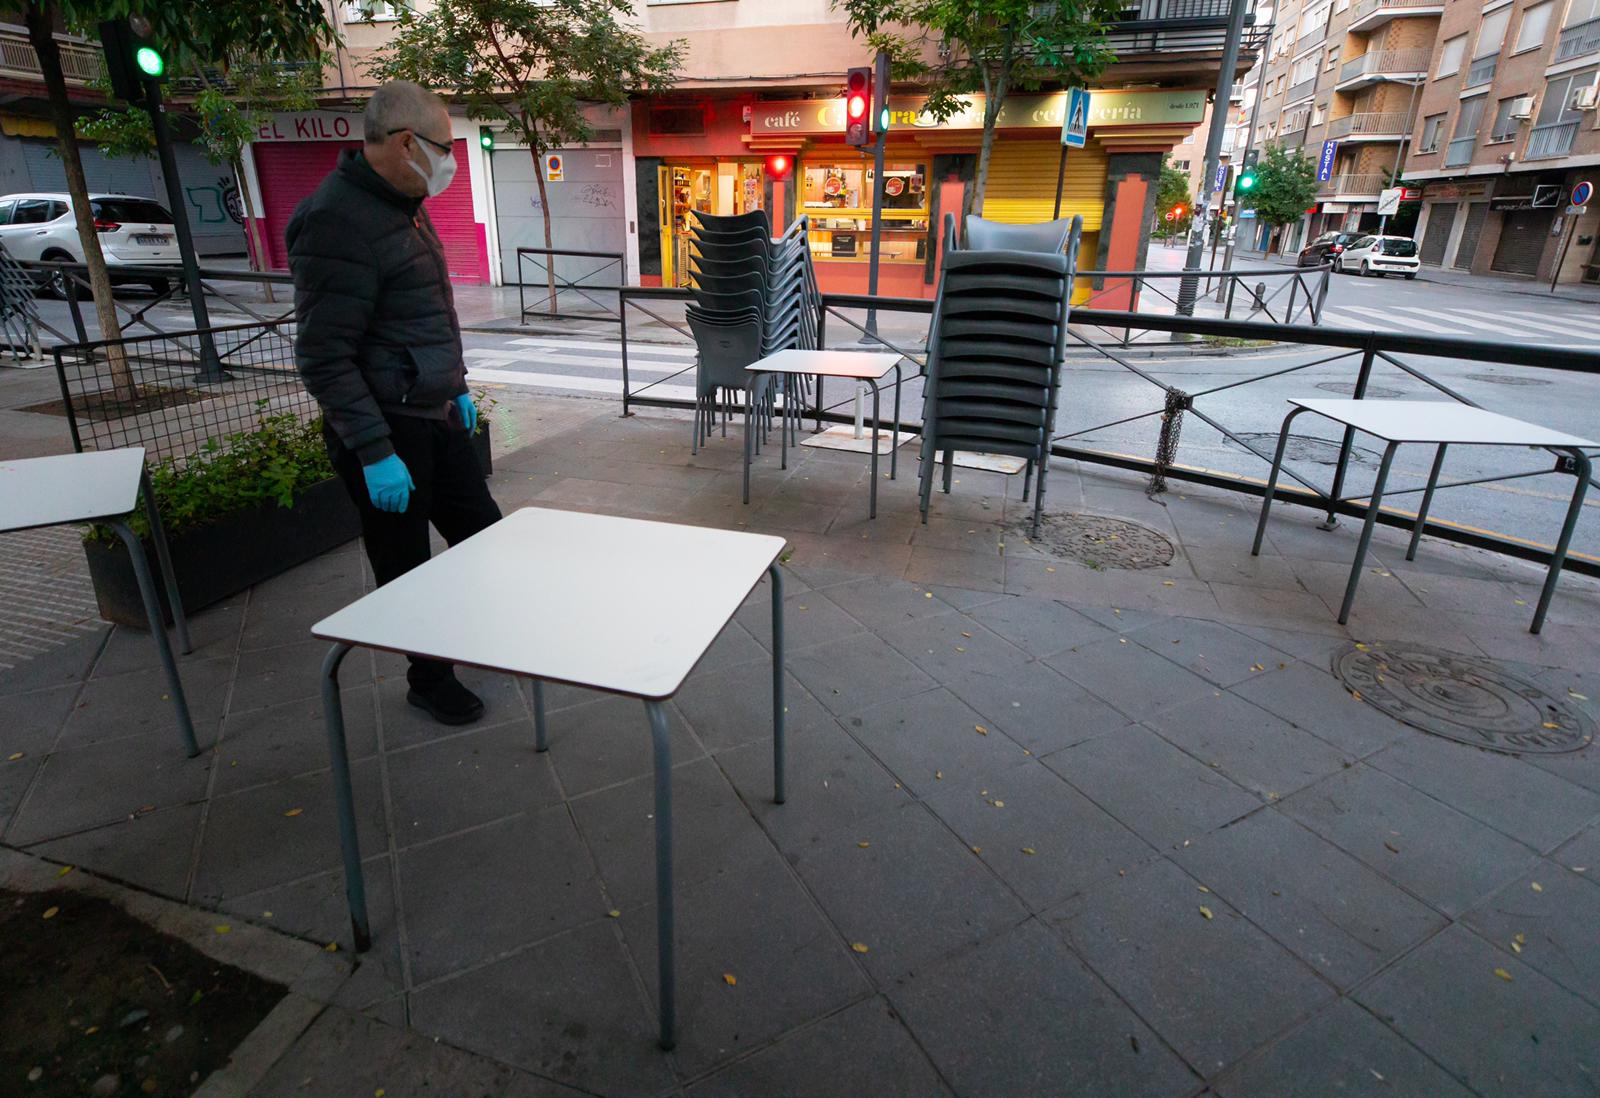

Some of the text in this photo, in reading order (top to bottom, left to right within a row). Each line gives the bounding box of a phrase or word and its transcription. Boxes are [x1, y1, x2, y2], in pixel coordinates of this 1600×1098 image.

[294, 116, 350, 138] KILO
[764, 111, 801, 128] café
[1320, 142, 1334, 181] HOSTAL
